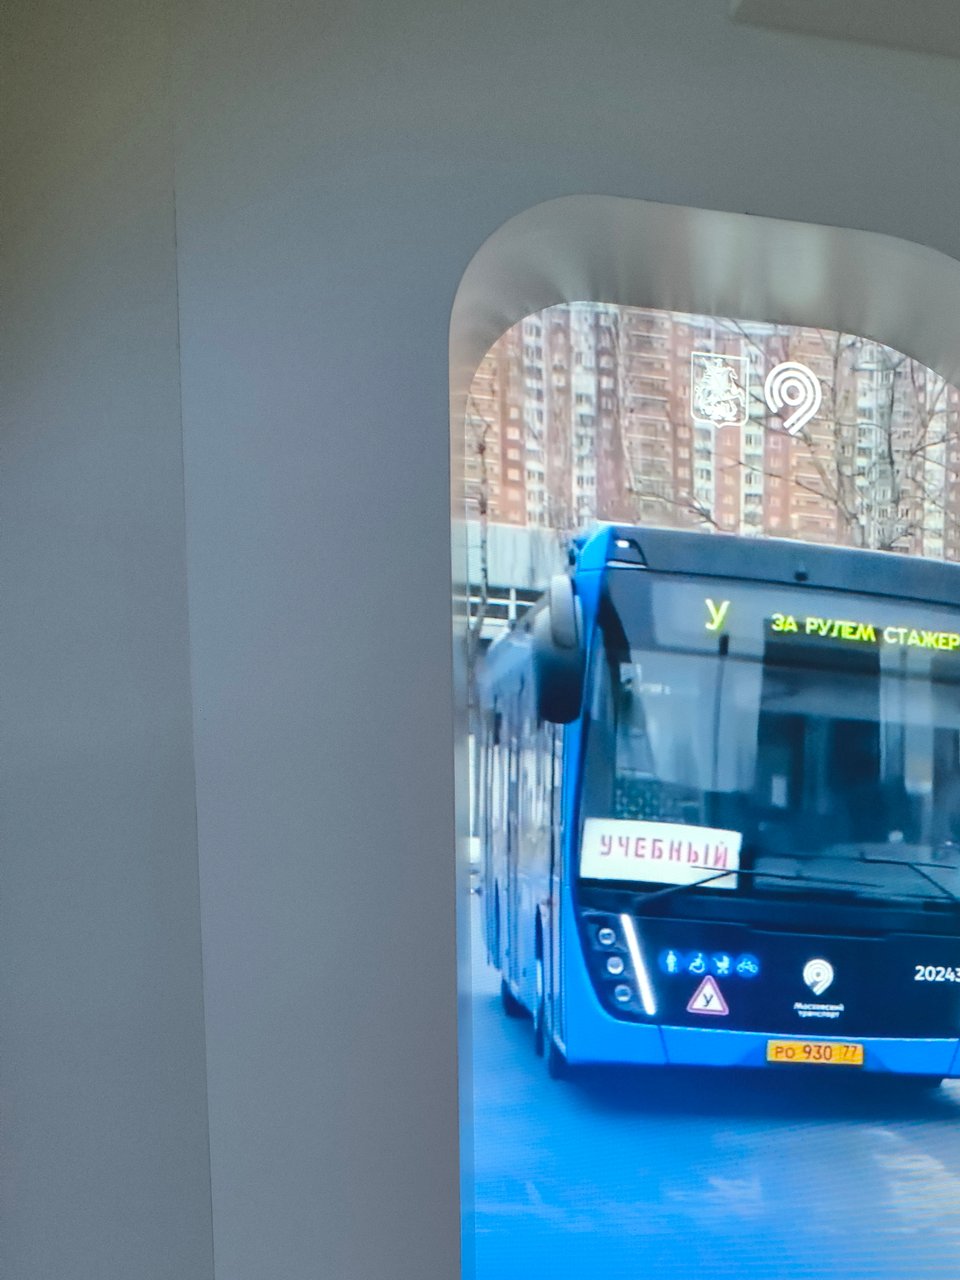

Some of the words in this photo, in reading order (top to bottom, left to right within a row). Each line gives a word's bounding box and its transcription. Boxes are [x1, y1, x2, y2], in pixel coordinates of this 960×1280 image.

[704, 598, 731, 631] У
[771, 612, 799, 633] ЗА
[805, 616, 877, 645] РУЛЕМ
[599, 833, 728, 869] УЧЕБНЫЙ
[802, 1044, 833, 1061] 930
[842, 1045, 858, 1060] 77
